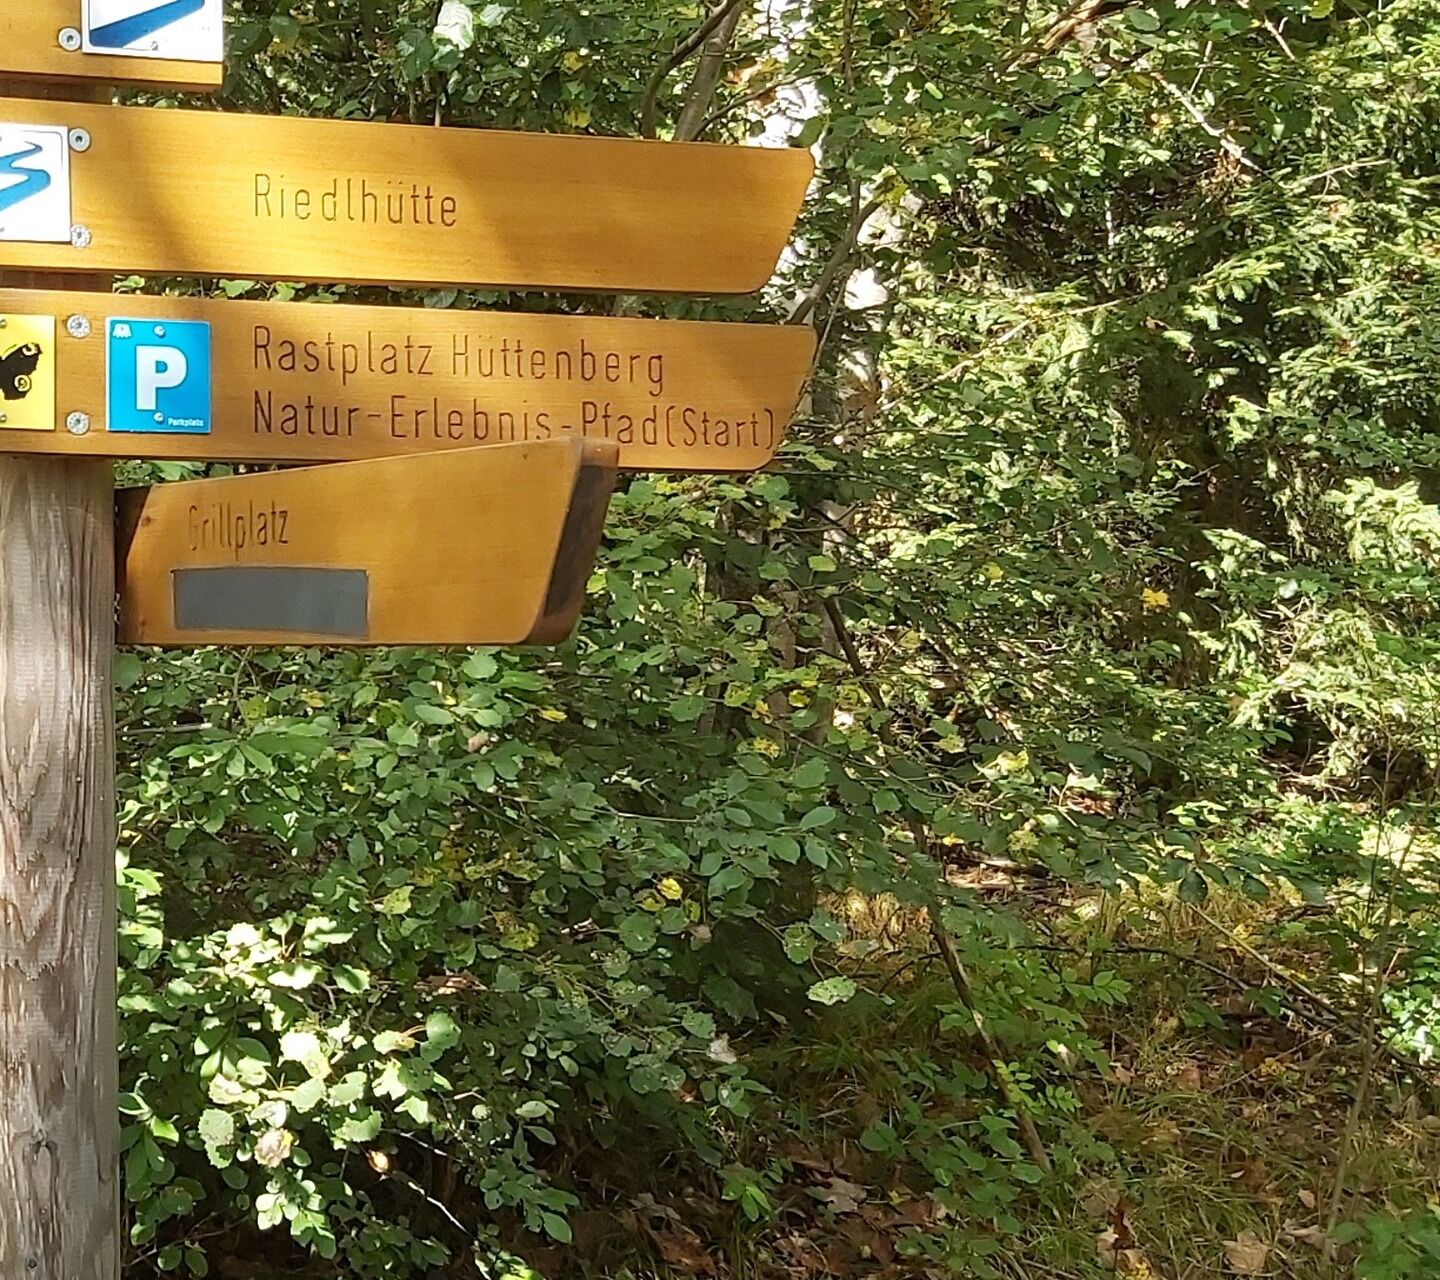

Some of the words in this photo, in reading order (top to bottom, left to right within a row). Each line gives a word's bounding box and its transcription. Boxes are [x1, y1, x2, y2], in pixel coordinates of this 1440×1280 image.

[254, 173, 458, 229] Riedlhütte
[135, 345, 188, 411] P
[253, 325, 434, 385] Rastplatz
[452, 334, 663, 397] Hüttenberg
[189, 500, 288, 561] Grillplatz
